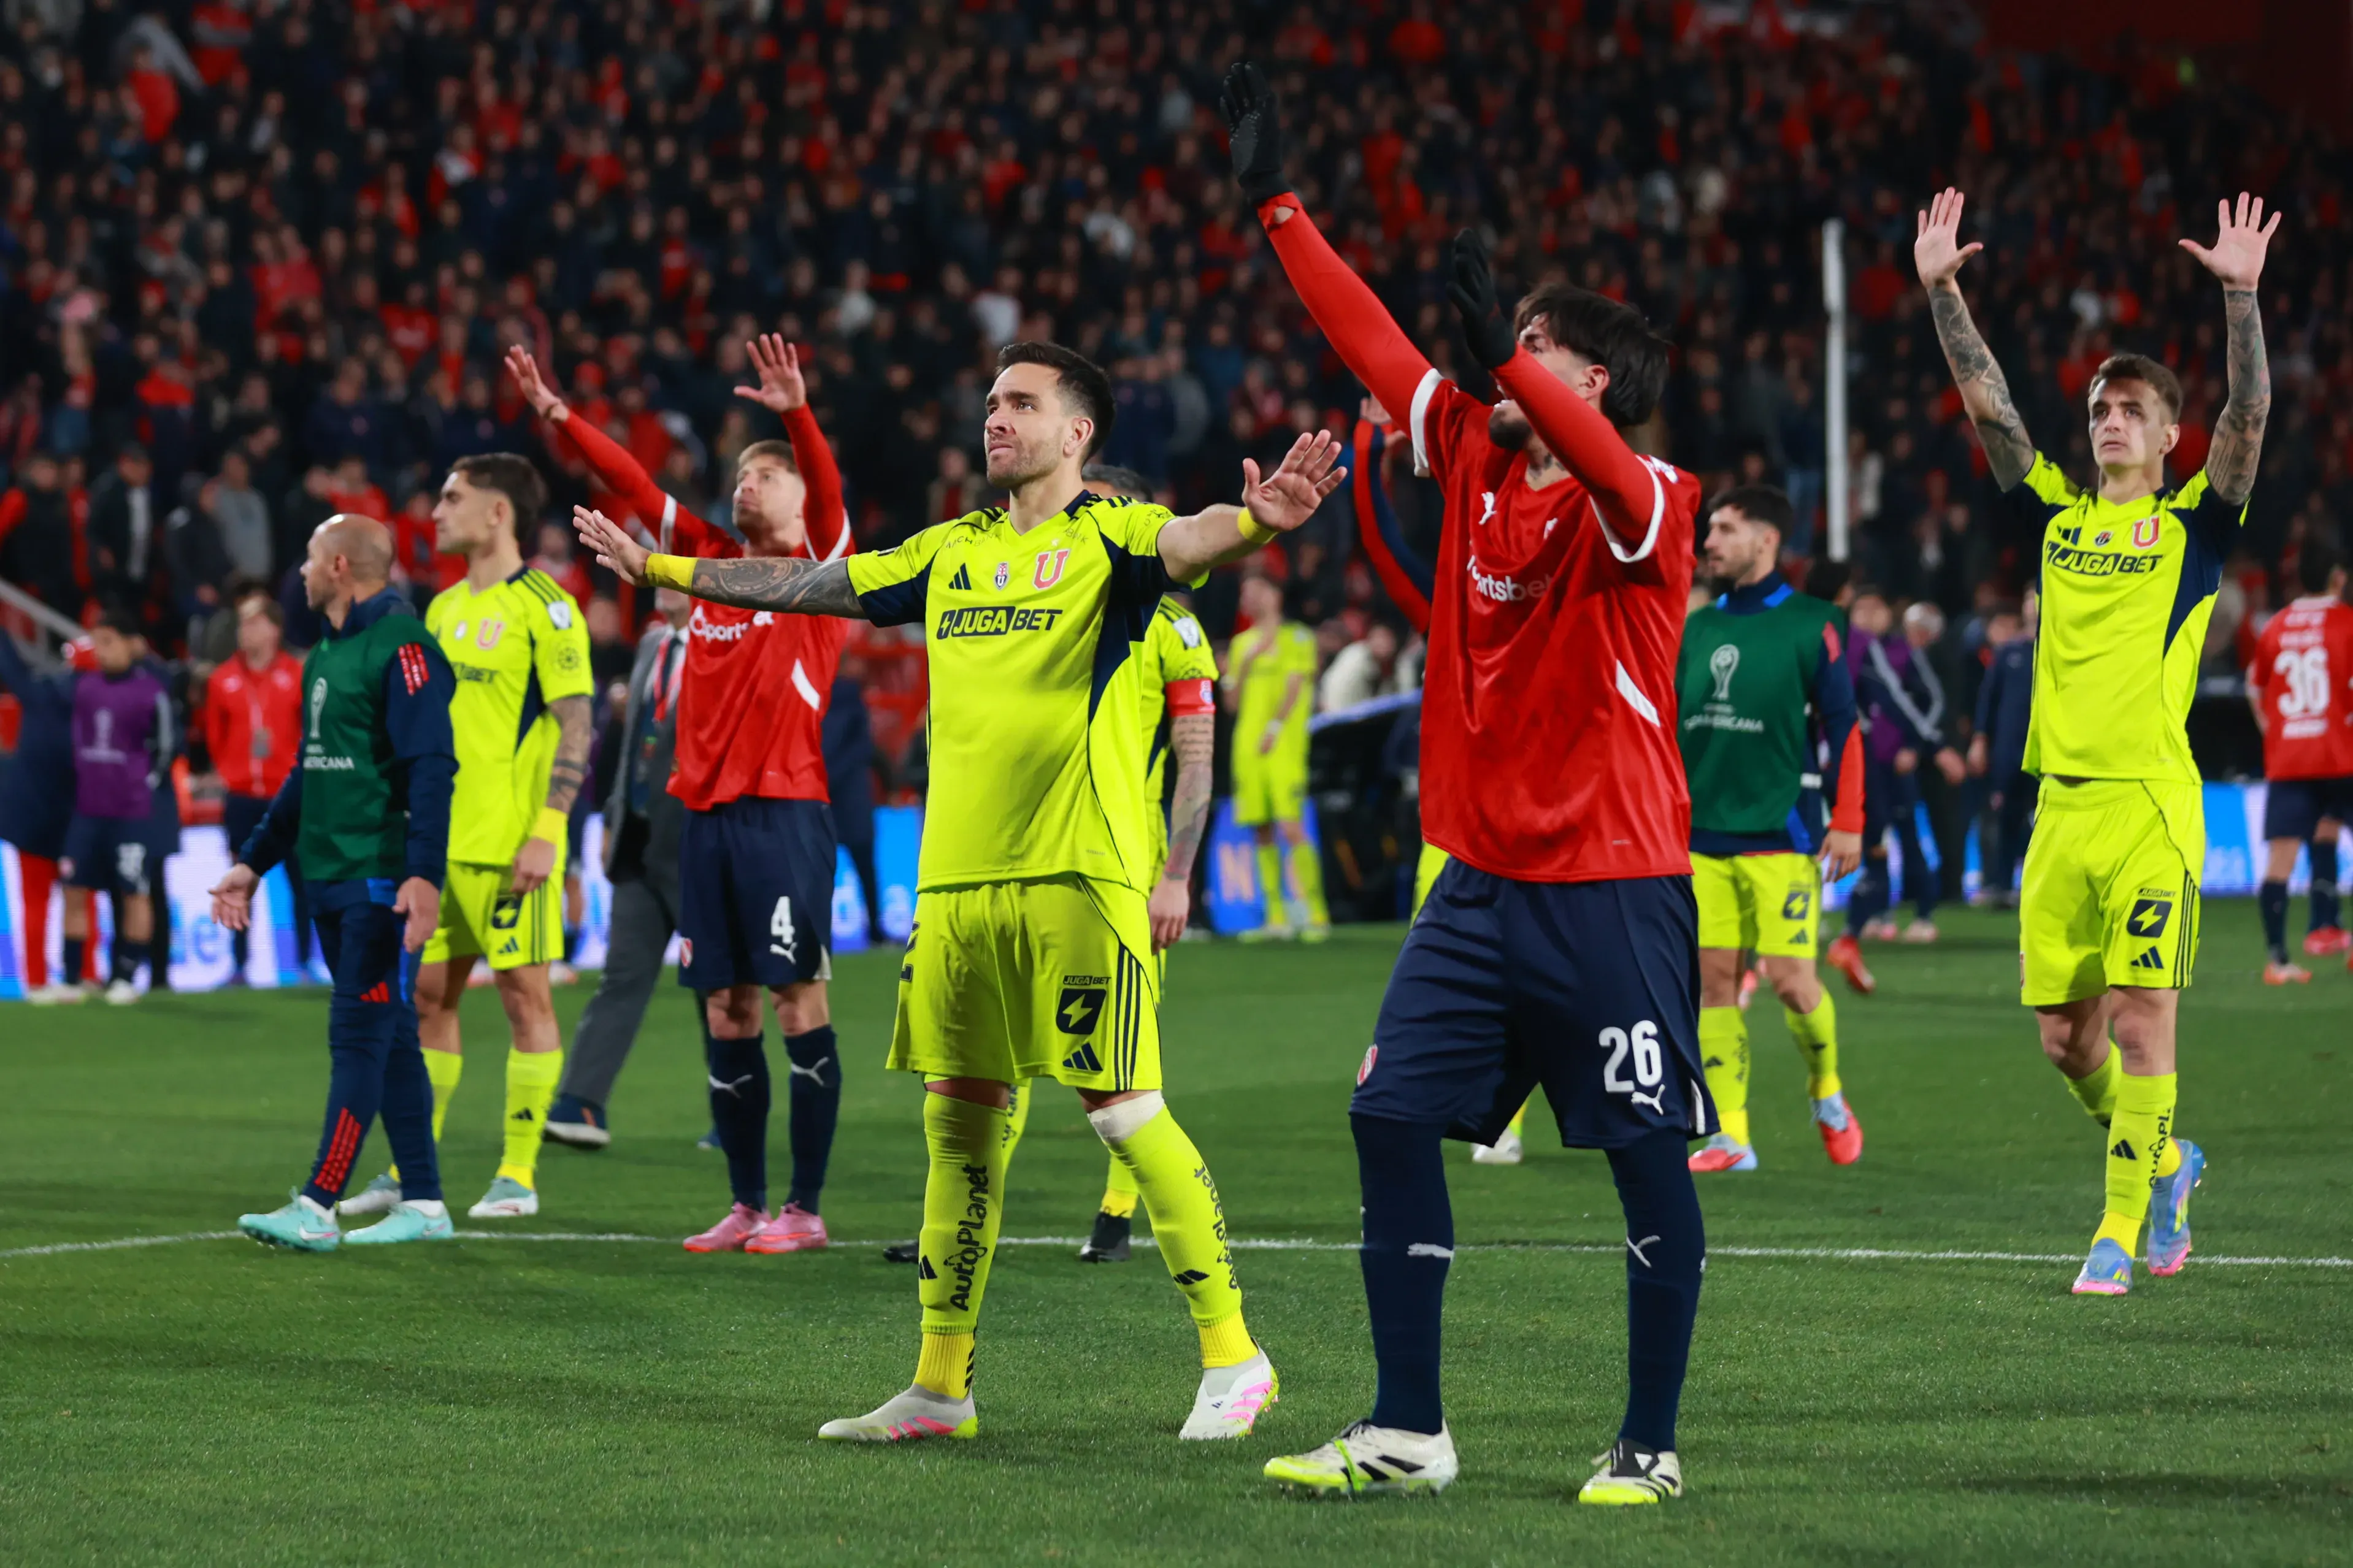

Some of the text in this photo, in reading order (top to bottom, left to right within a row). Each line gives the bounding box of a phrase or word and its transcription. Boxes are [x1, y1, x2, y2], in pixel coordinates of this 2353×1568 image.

[2132, 516, 2160, 549] U
[1033, 549, 1071, 590] U
[2274, 645, 2330, 717] 36
[770, 895, 796, 944] 4
[1599, 1020, 1663, 1093] 26
[943, 1163, 989, 1312] AutoPlanet
